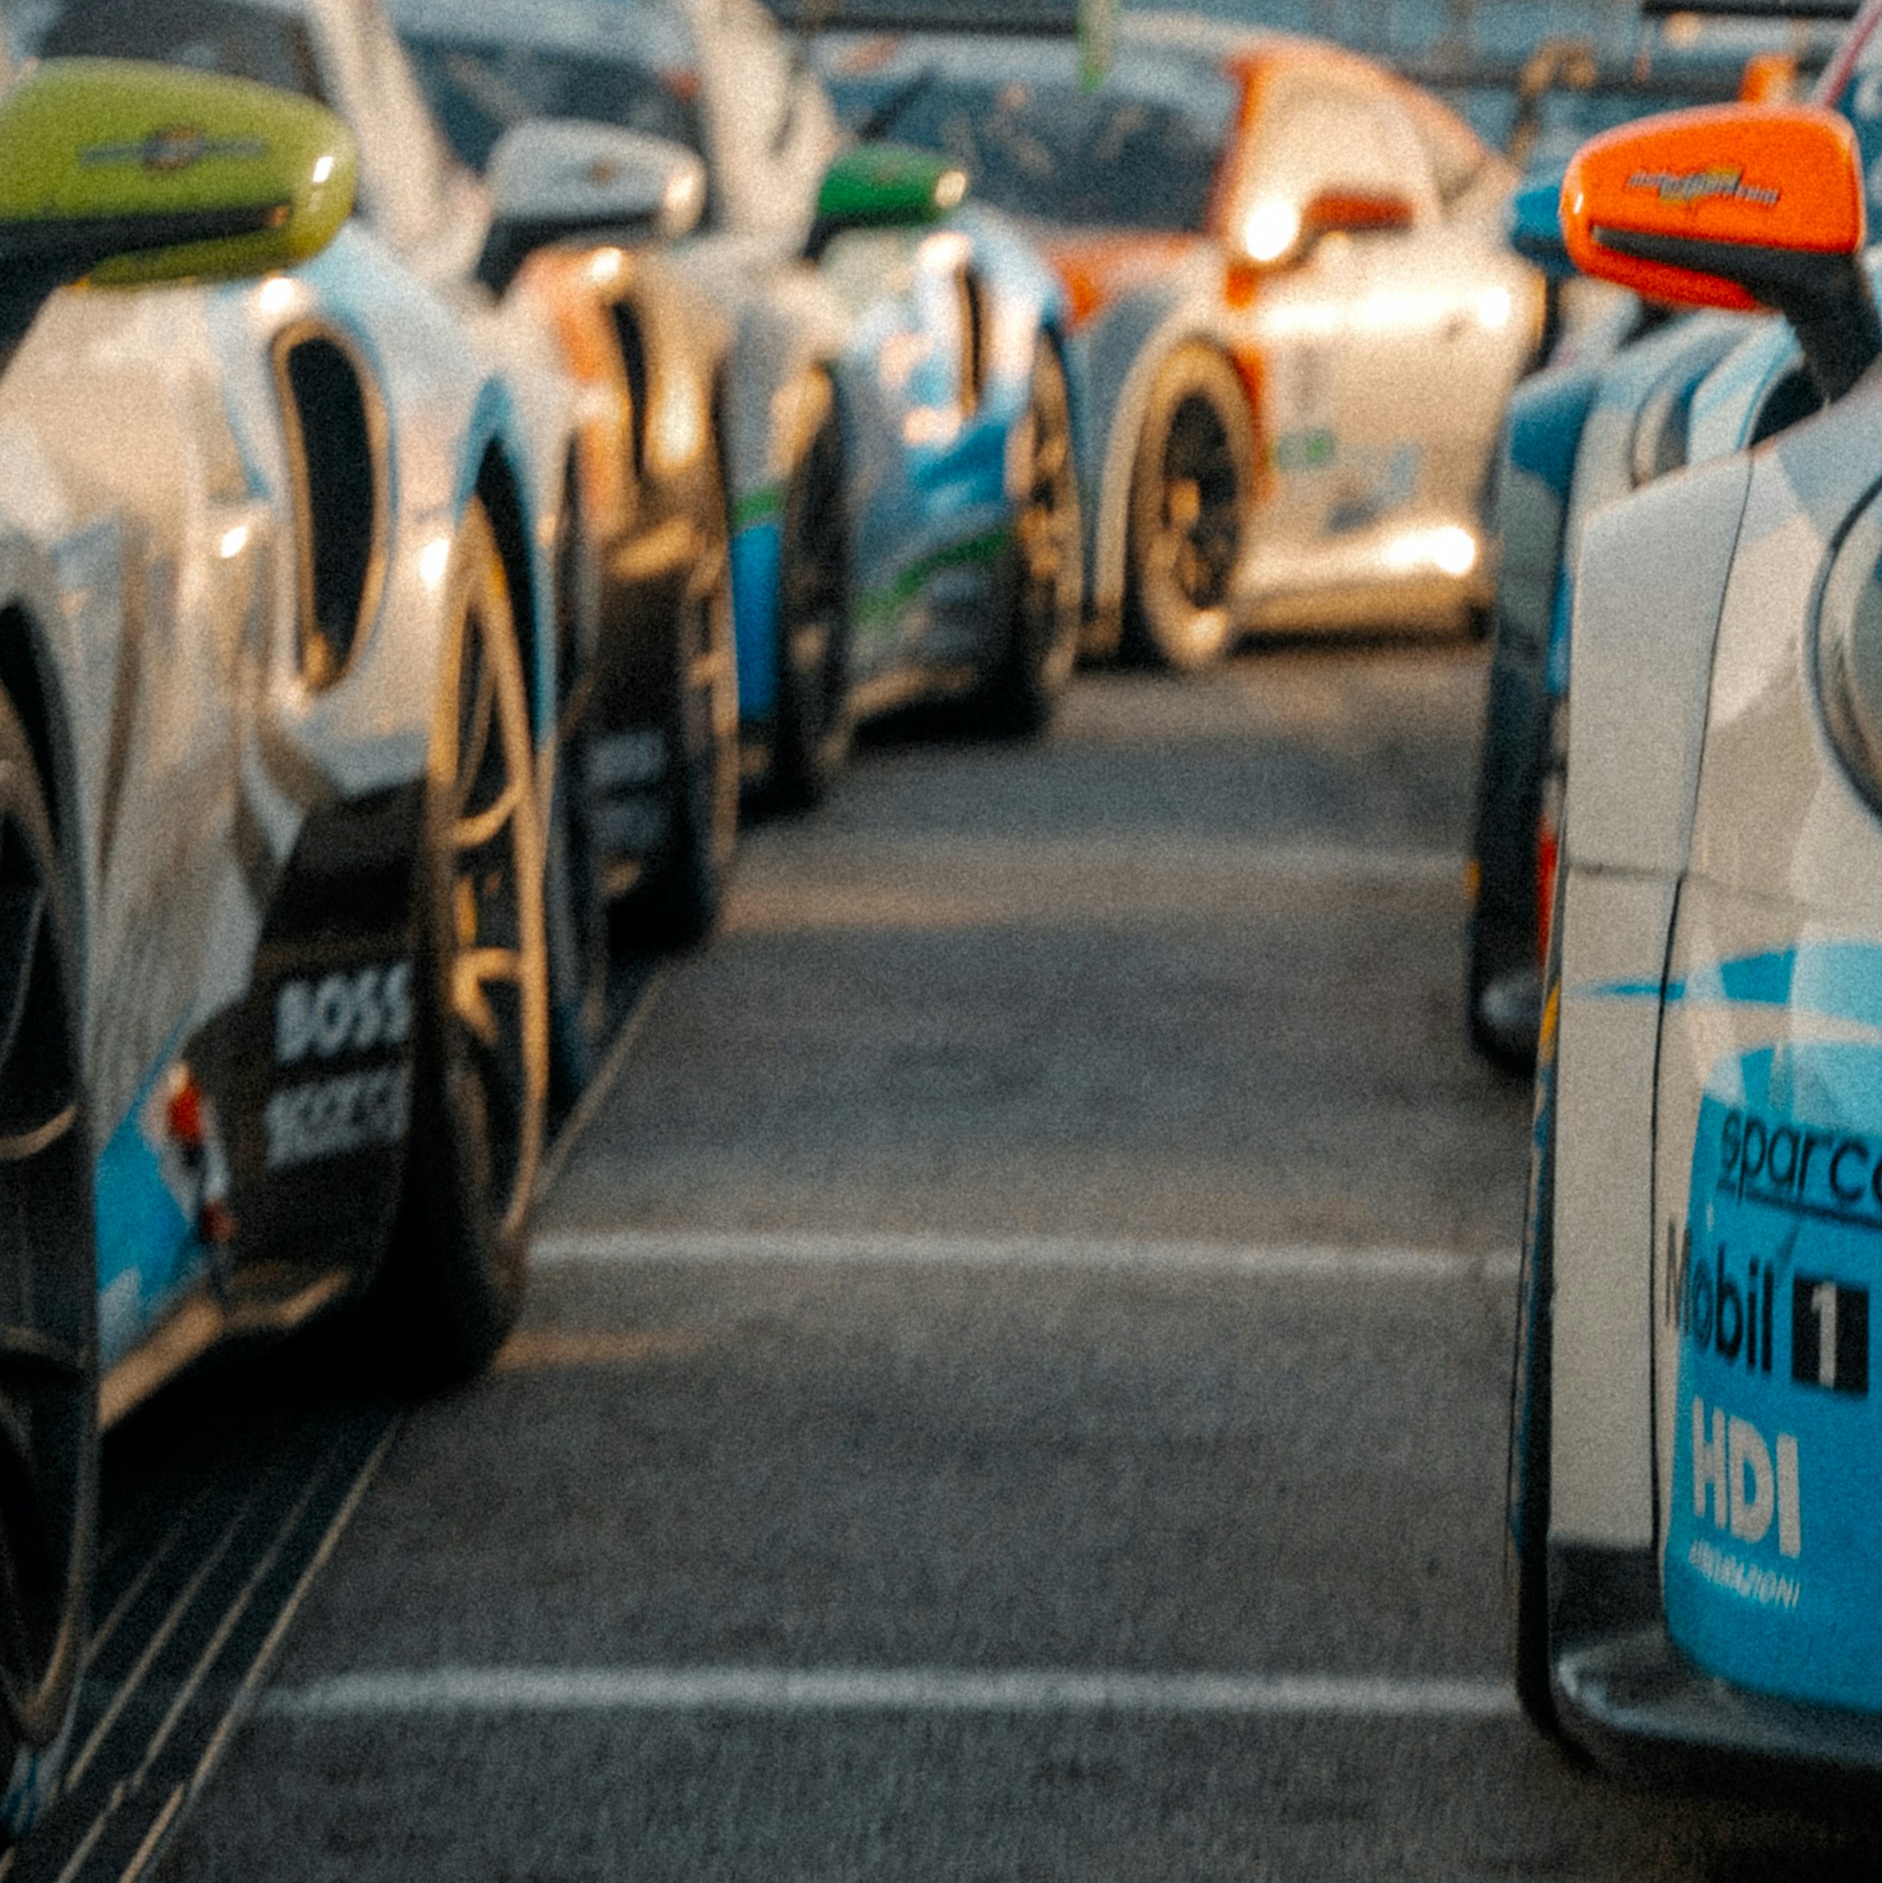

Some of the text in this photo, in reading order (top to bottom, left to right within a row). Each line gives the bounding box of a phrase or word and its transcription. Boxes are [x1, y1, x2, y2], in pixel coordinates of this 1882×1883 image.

[1664, 1219, 1839, 1391] Mobil 1
[1690, 1397, 1801, 1559] HDI
